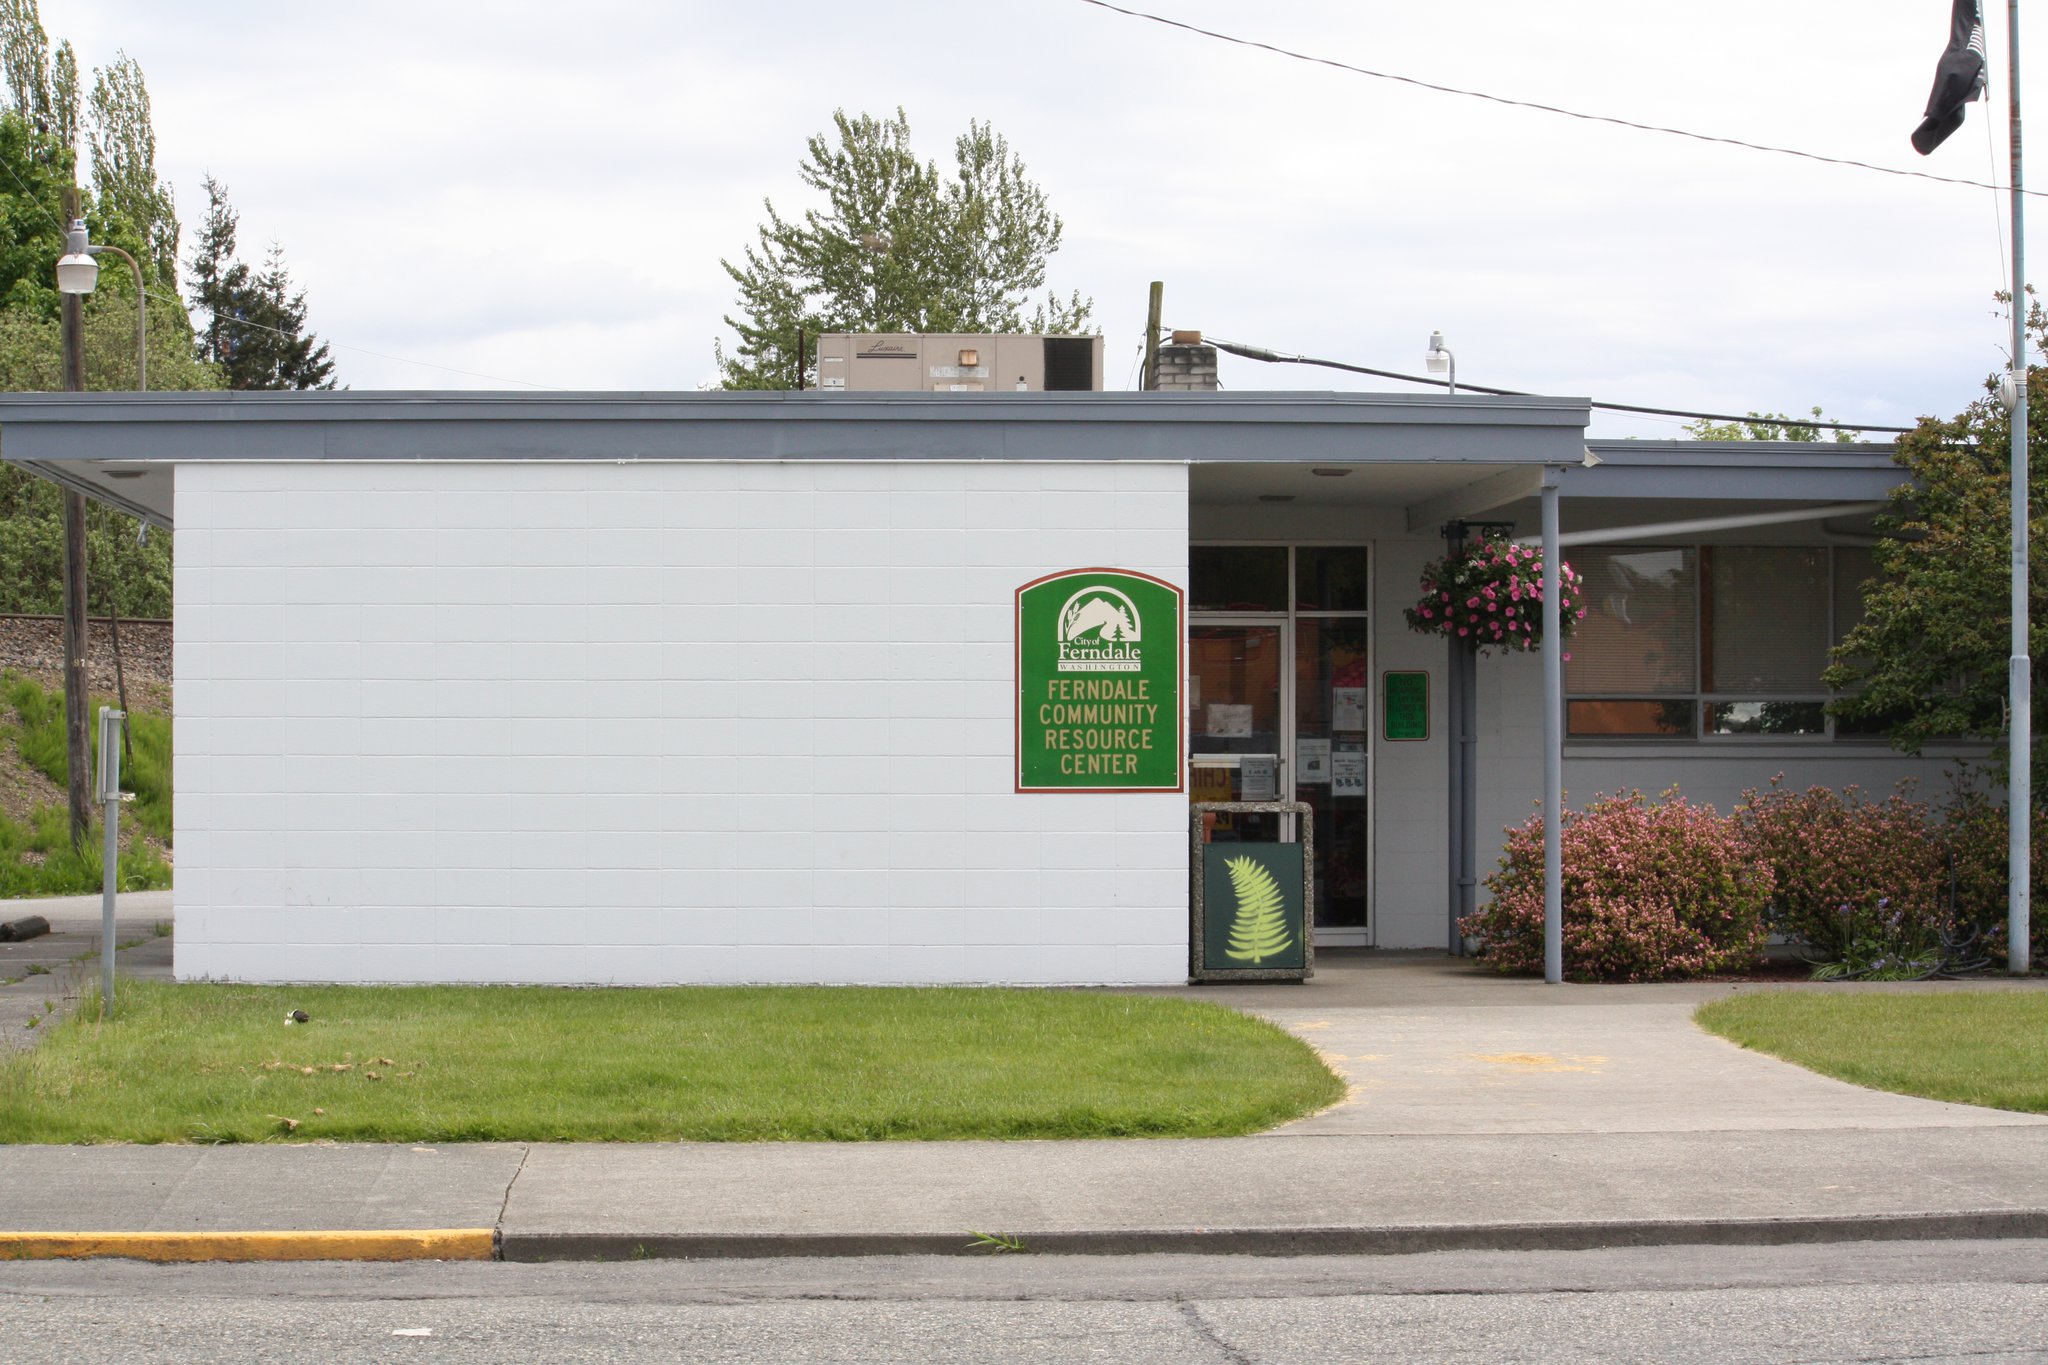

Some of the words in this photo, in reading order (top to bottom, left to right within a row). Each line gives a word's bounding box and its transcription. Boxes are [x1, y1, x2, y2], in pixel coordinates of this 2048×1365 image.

[1058, 642, 1141, 660] Ferndale
[1073, 636, 1092, 647] City
[1091, 635, 1100, 646] of
[1048, 680, 1149, 700] FERNDALE
[1039, 704, 1158, 725] COMMUNITY
[1045, 729, 1153, 750] RESOURCE
[1061, 754, 1138, 774] CENTER
